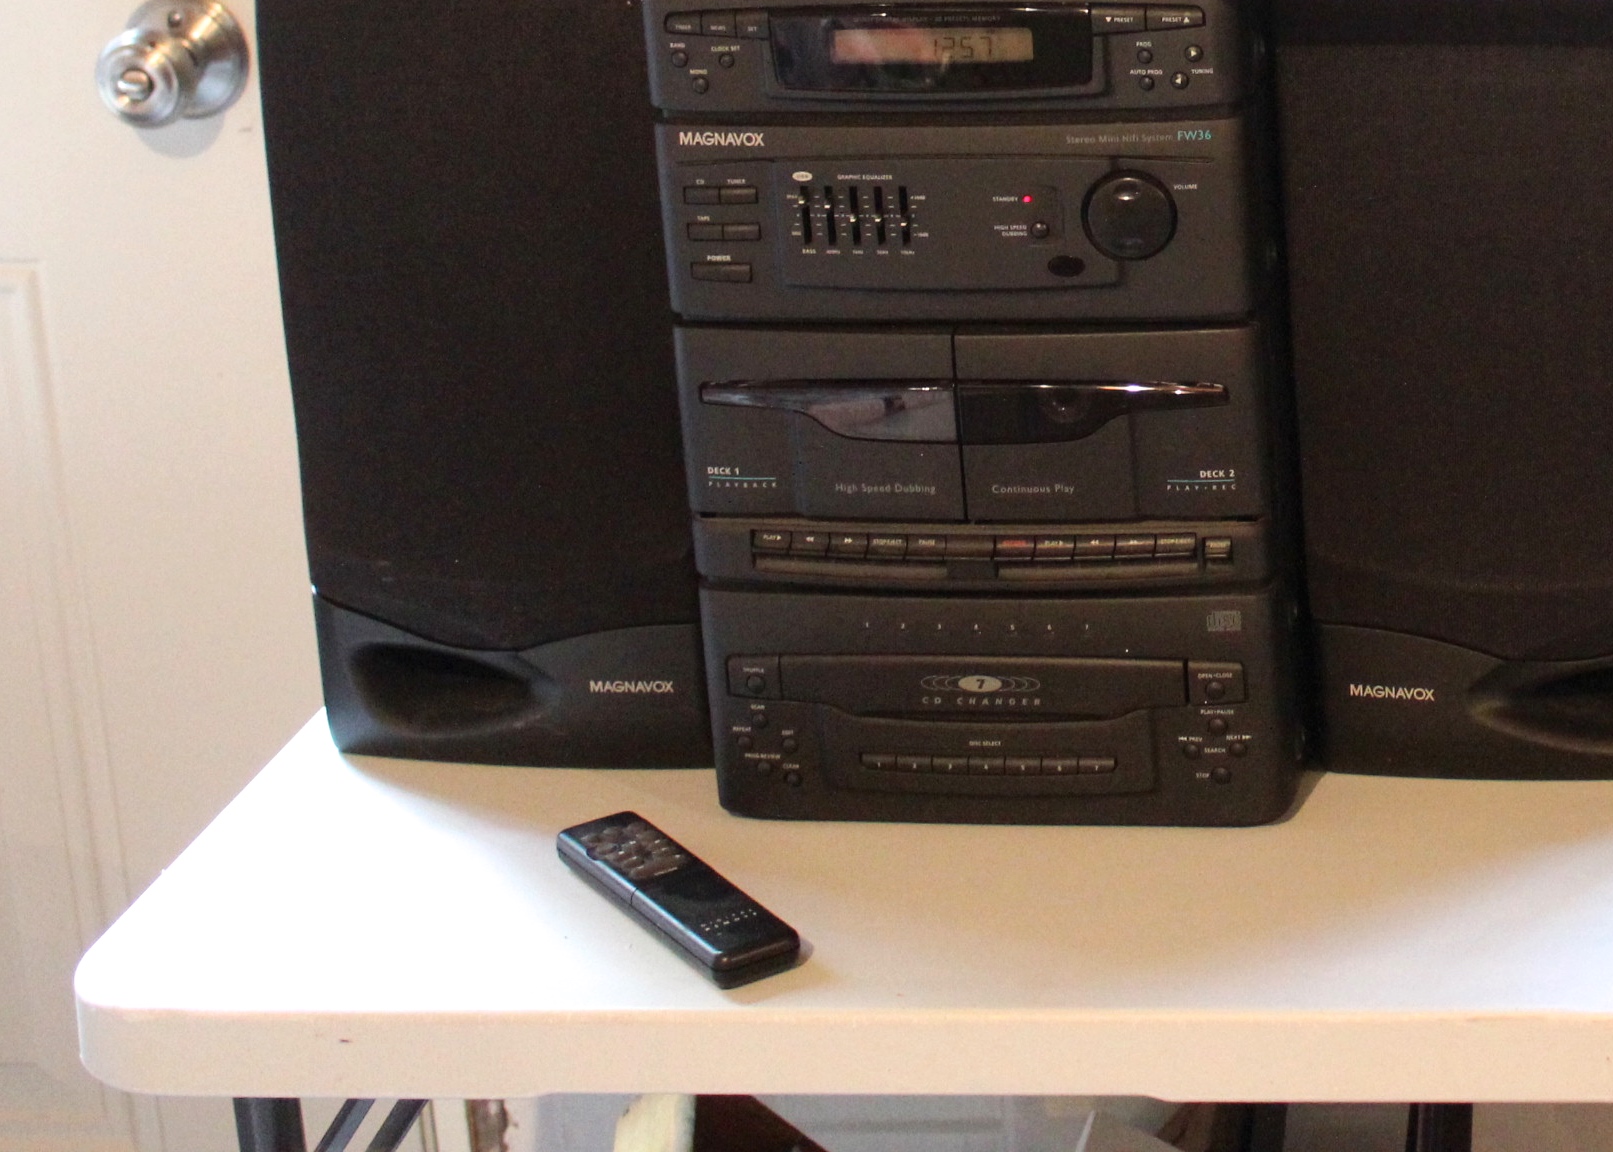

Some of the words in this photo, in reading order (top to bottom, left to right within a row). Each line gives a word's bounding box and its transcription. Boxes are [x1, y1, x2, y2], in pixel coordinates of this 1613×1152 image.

[679, 131, 765, 147] MAGNAVOX
[1066, 134, 1095, 144] Stereo
[1142, 133, 1173, 144] System
[1177, 129, 1212, 141] FW36
[707, 466, 731, 475] DECK
[734, 467, 740, 475] 1
[1200, 469, 1225, 478] DECK
[1229, 469, 1235, 477] 2
[836, 483, 857, 493] High
[861, 483, 891, 494] Speed
[895, 483, 937, 495] Dubbing
[992, 484, 1051, 494] Continuous
[1055, 484, 1075, 495] Play
[589, 680, 675, 693] MAGNAVOX
[976, 678, 986, 690] 7
[1349, 684, 1435, 702] MAGNAVOX
[922, 697, 942, 705] CD
[956, 697, 1041, 706] CHANGER
